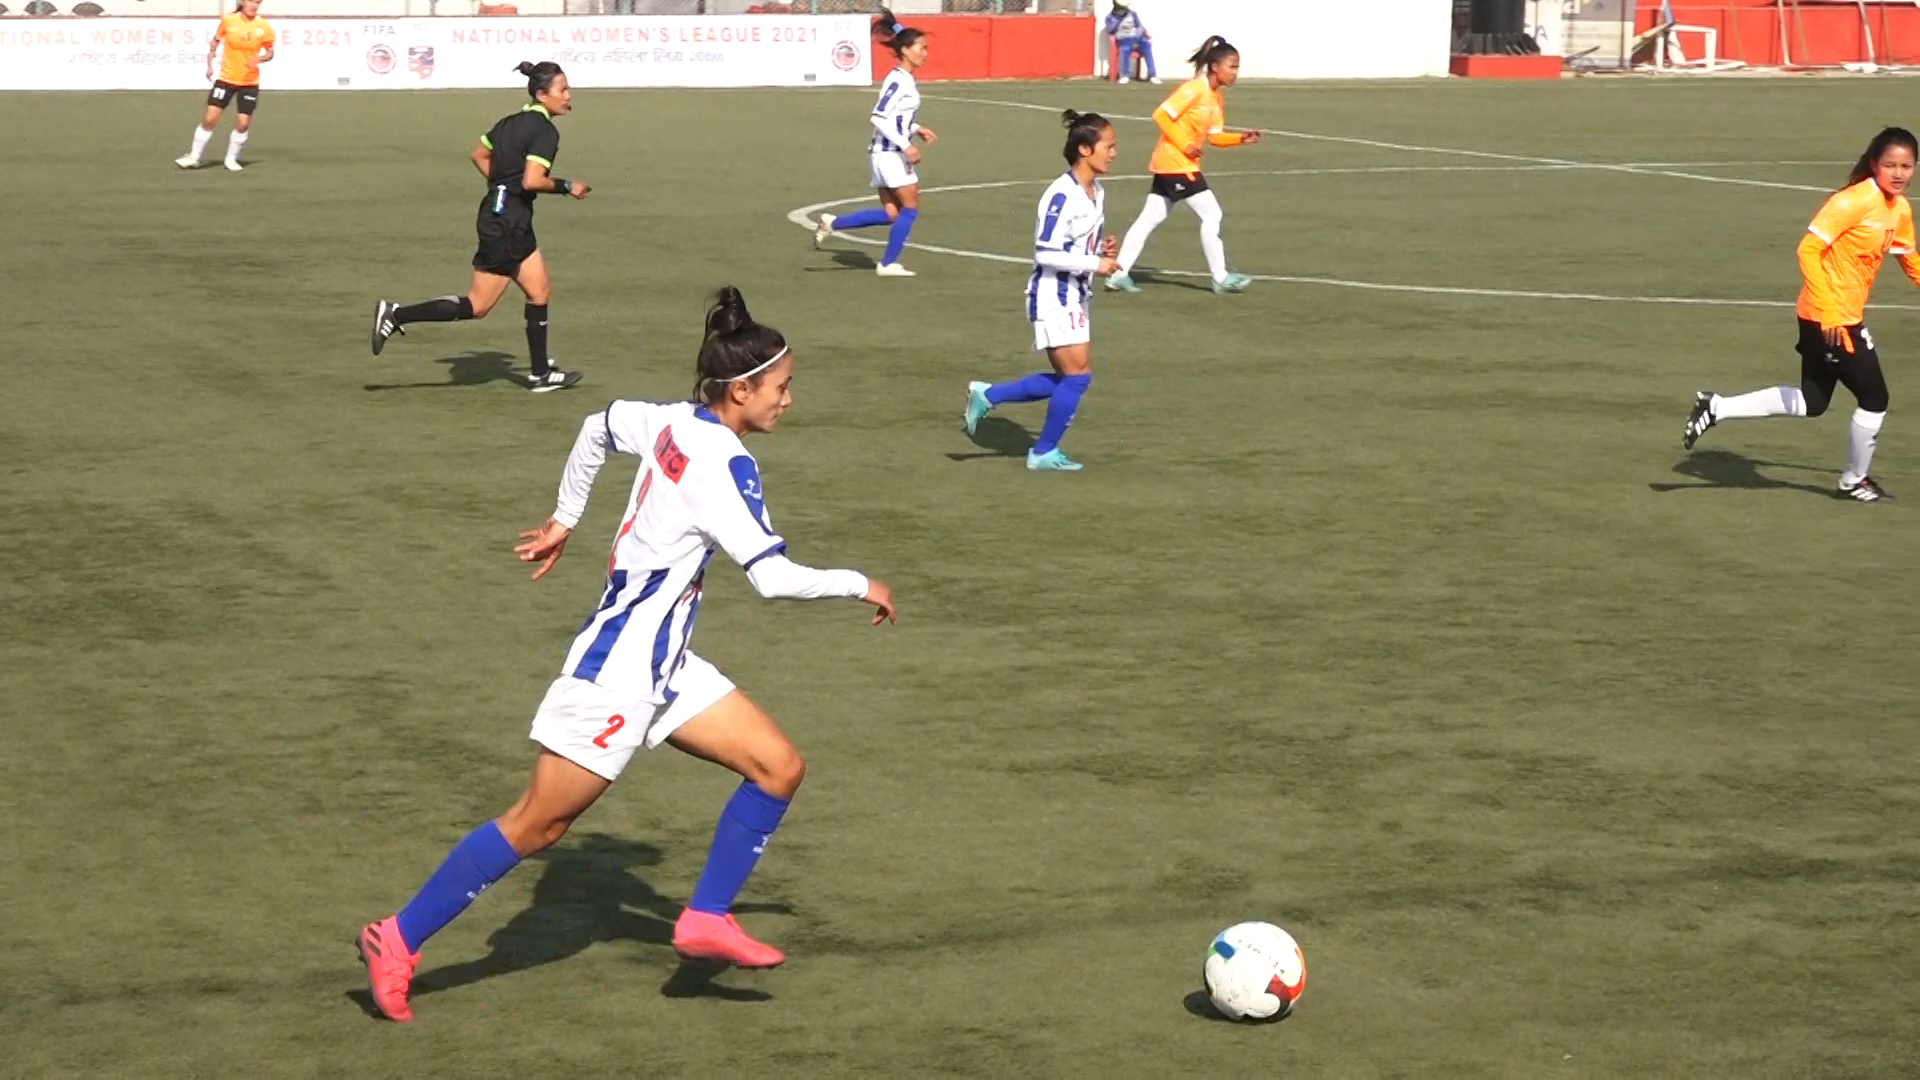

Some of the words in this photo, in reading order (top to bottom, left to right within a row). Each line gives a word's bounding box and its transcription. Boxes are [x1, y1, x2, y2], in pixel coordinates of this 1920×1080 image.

[90, 29, 195, 45] WOMEN'S
[303, 29, 352, 45] 2021
[452, 28, 561, 44] NATIONAL
[571, 27, 670, 43] WOMEN'S
[680, 27, 762, 42] LEAGUE
[771, 26, 818, 42] 2021
[592, 713, 625, 750] 2
